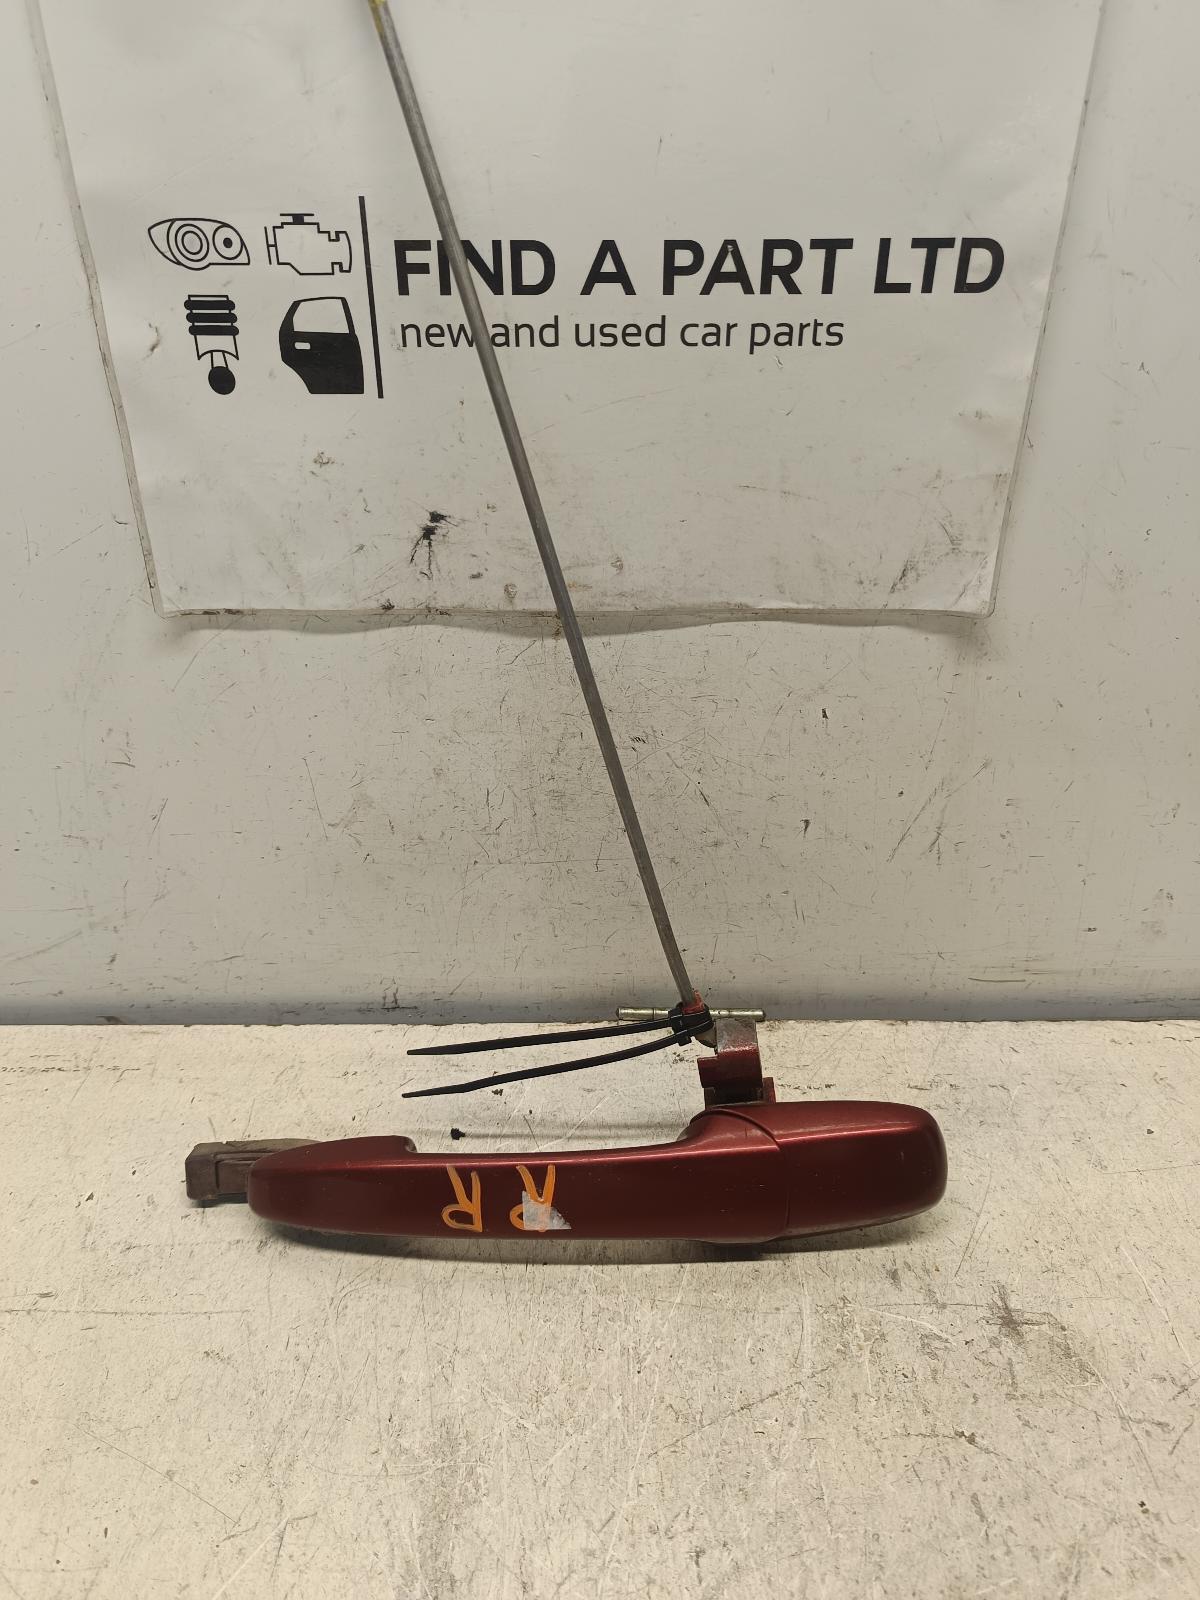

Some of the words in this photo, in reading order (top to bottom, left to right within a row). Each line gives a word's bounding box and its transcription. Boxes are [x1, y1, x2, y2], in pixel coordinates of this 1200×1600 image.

[393, 239, 556, 296] FIND
[579, 239, 637, 296] A
[662, 238, 854, 296] PART
[873, 237, 1005, 295] LTD
[400, 322, 478, 348] new
[489, 314, 560, 348] and
[574, 314, 667, 348] used
[679, 322, 738, 348] car
[748, 318, 845, 355] parts
